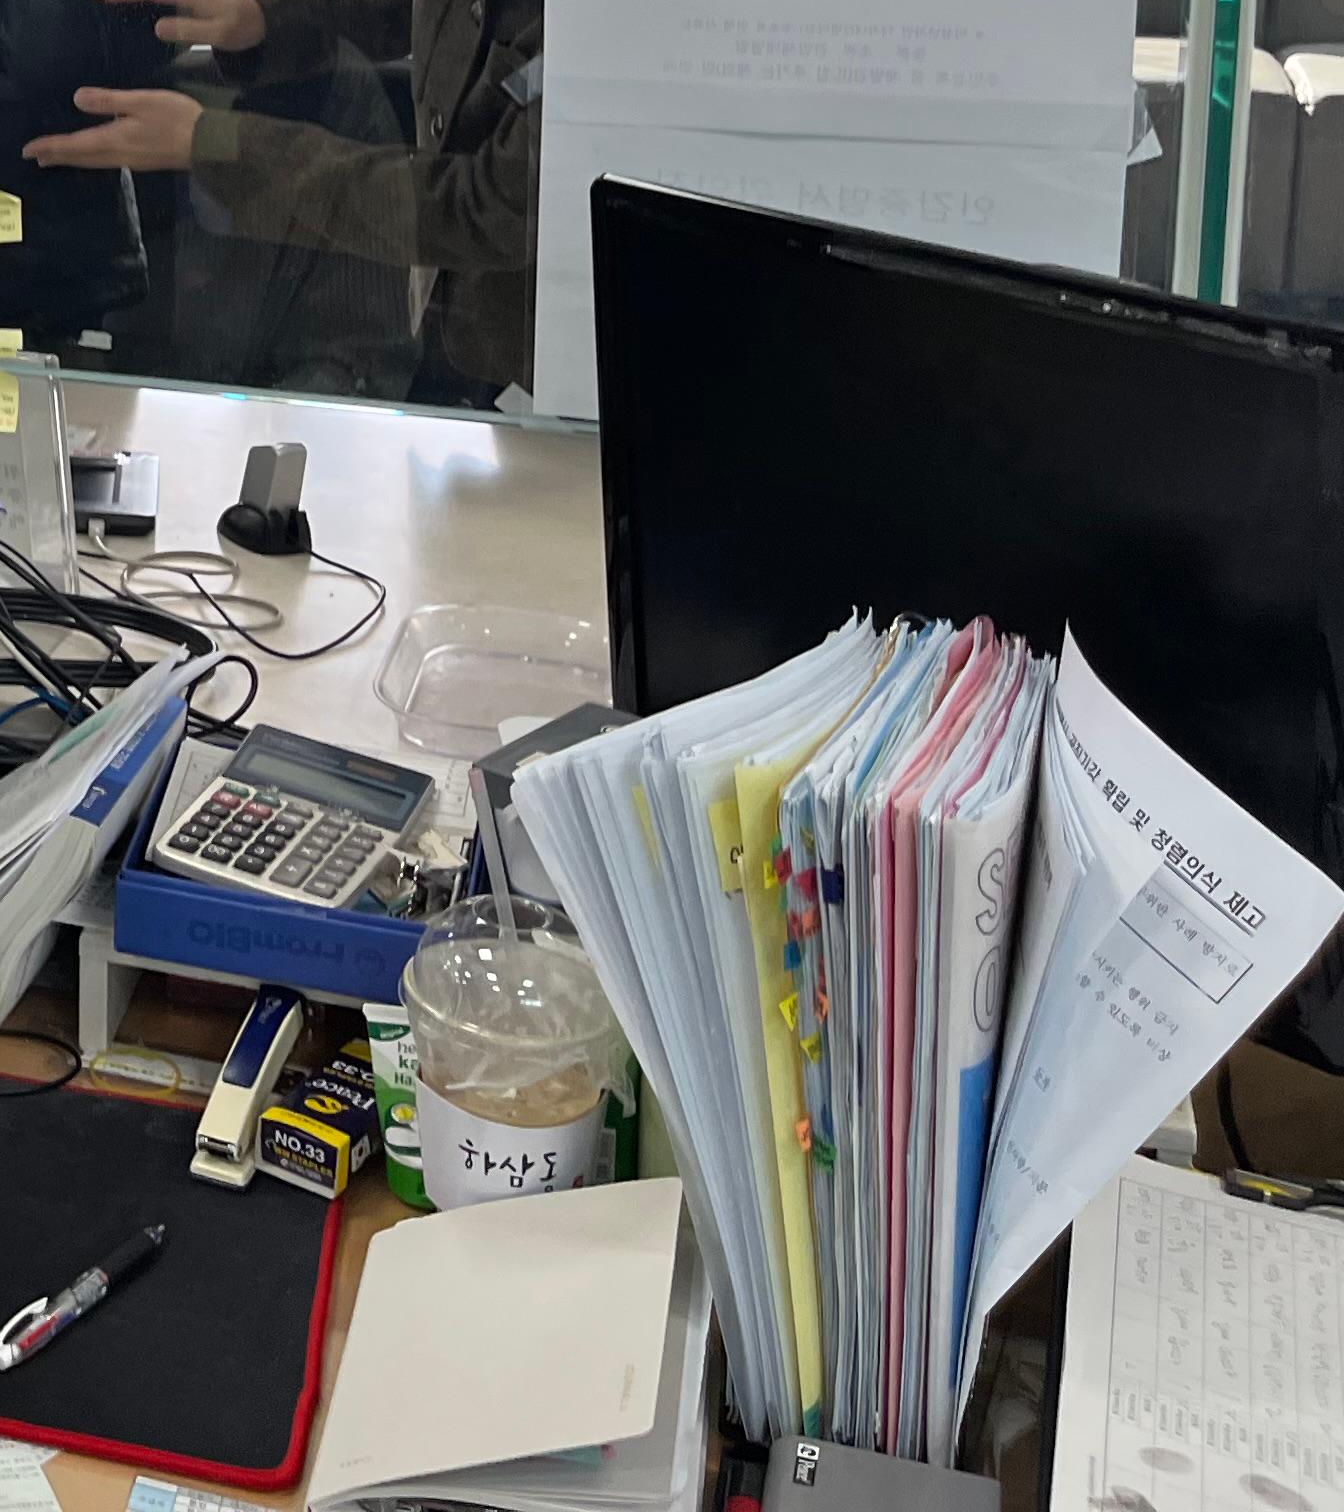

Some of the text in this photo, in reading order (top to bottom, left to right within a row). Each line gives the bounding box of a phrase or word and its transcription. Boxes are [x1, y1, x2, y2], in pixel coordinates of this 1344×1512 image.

[1102, 777, 1131, 814] 확립
[1130, 808, 1152, 833] 및
[1150, 827, 1223, 894] 청렴의식
[1222, 889, 1268, 931] 제고
[273, 1129, 326, 1164] NO.33
[457, 1139, 558, 1194] 하삼동
